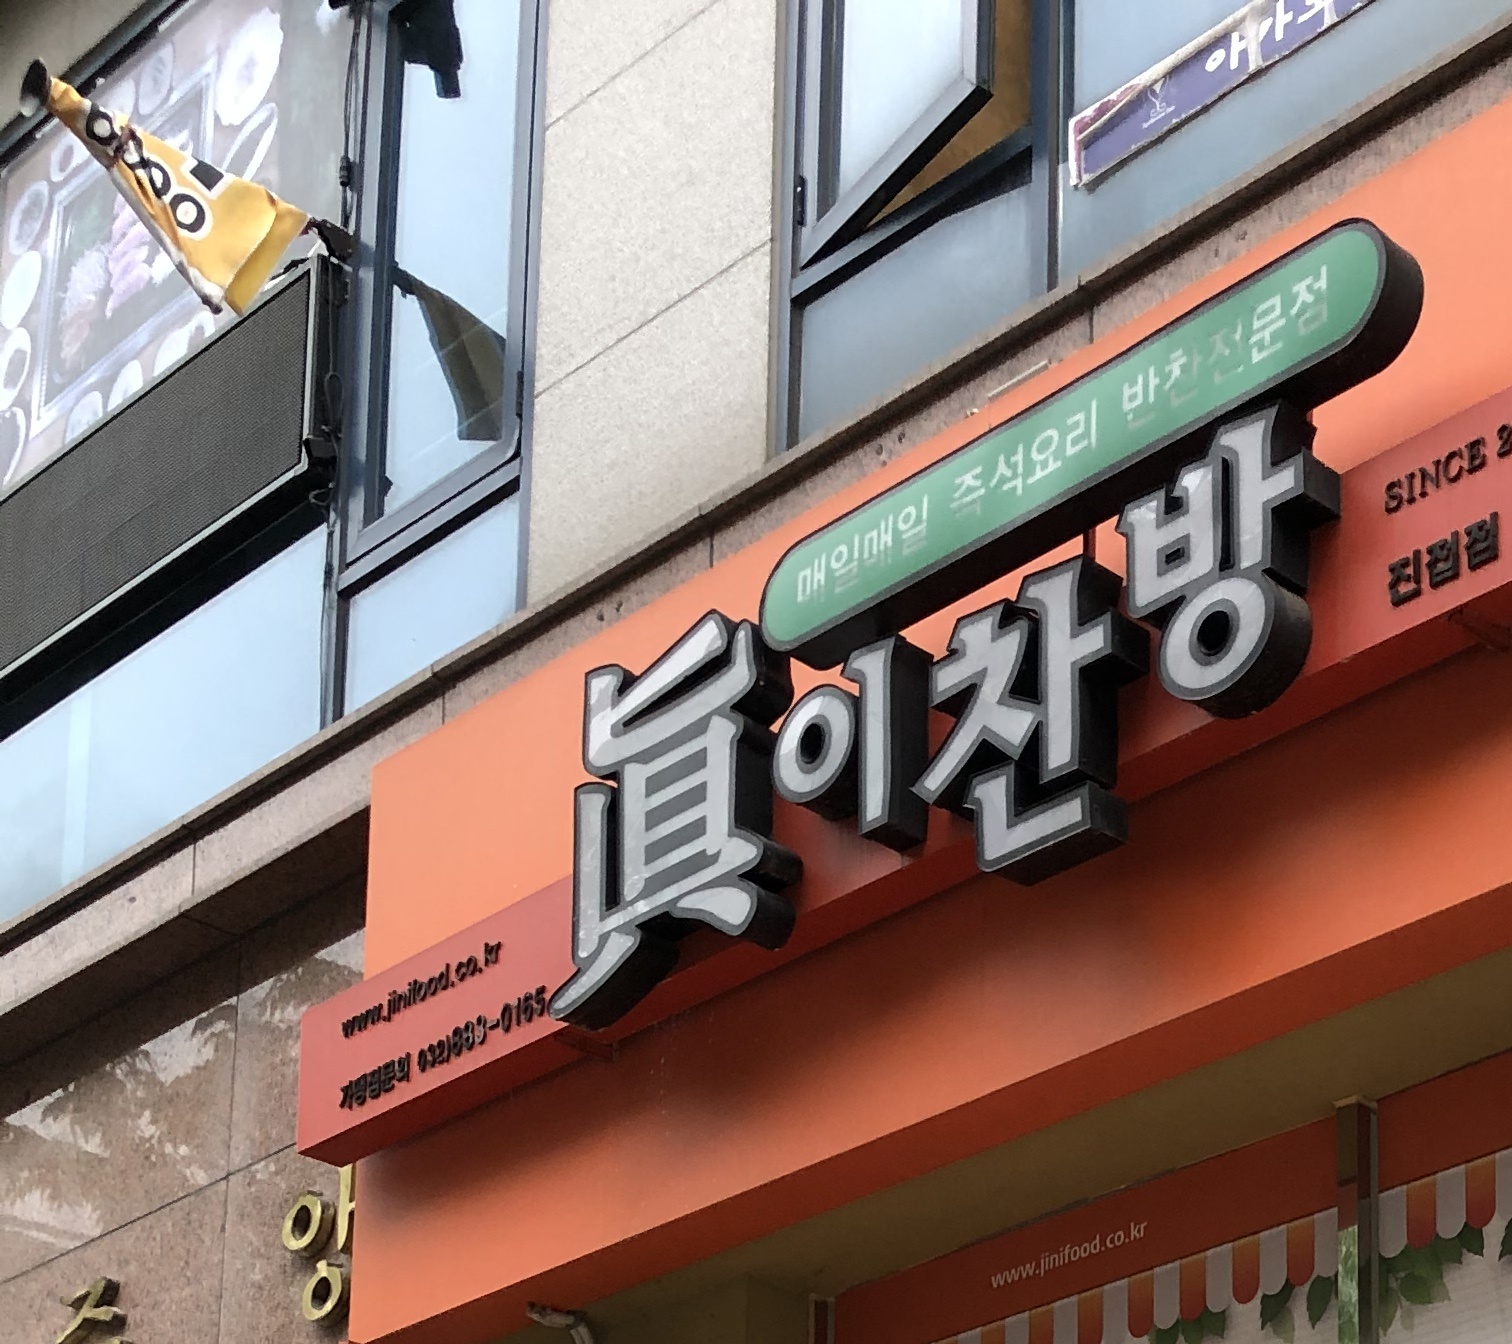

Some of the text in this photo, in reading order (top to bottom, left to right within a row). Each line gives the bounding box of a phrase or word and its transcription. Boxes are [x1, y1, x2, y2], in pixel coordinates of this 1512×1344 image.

[796, 264, 1329, 606] 매일매일 즉석요리 반찬전문점
[1383, 433, 1487, 514] SINCE
[1387, 510, 1500, 607] 진접점
[341, 941, 502, 1039] www.jinifood.co.kr
[991, 1220, 1148, 1290] www.jinifood.co.kr
